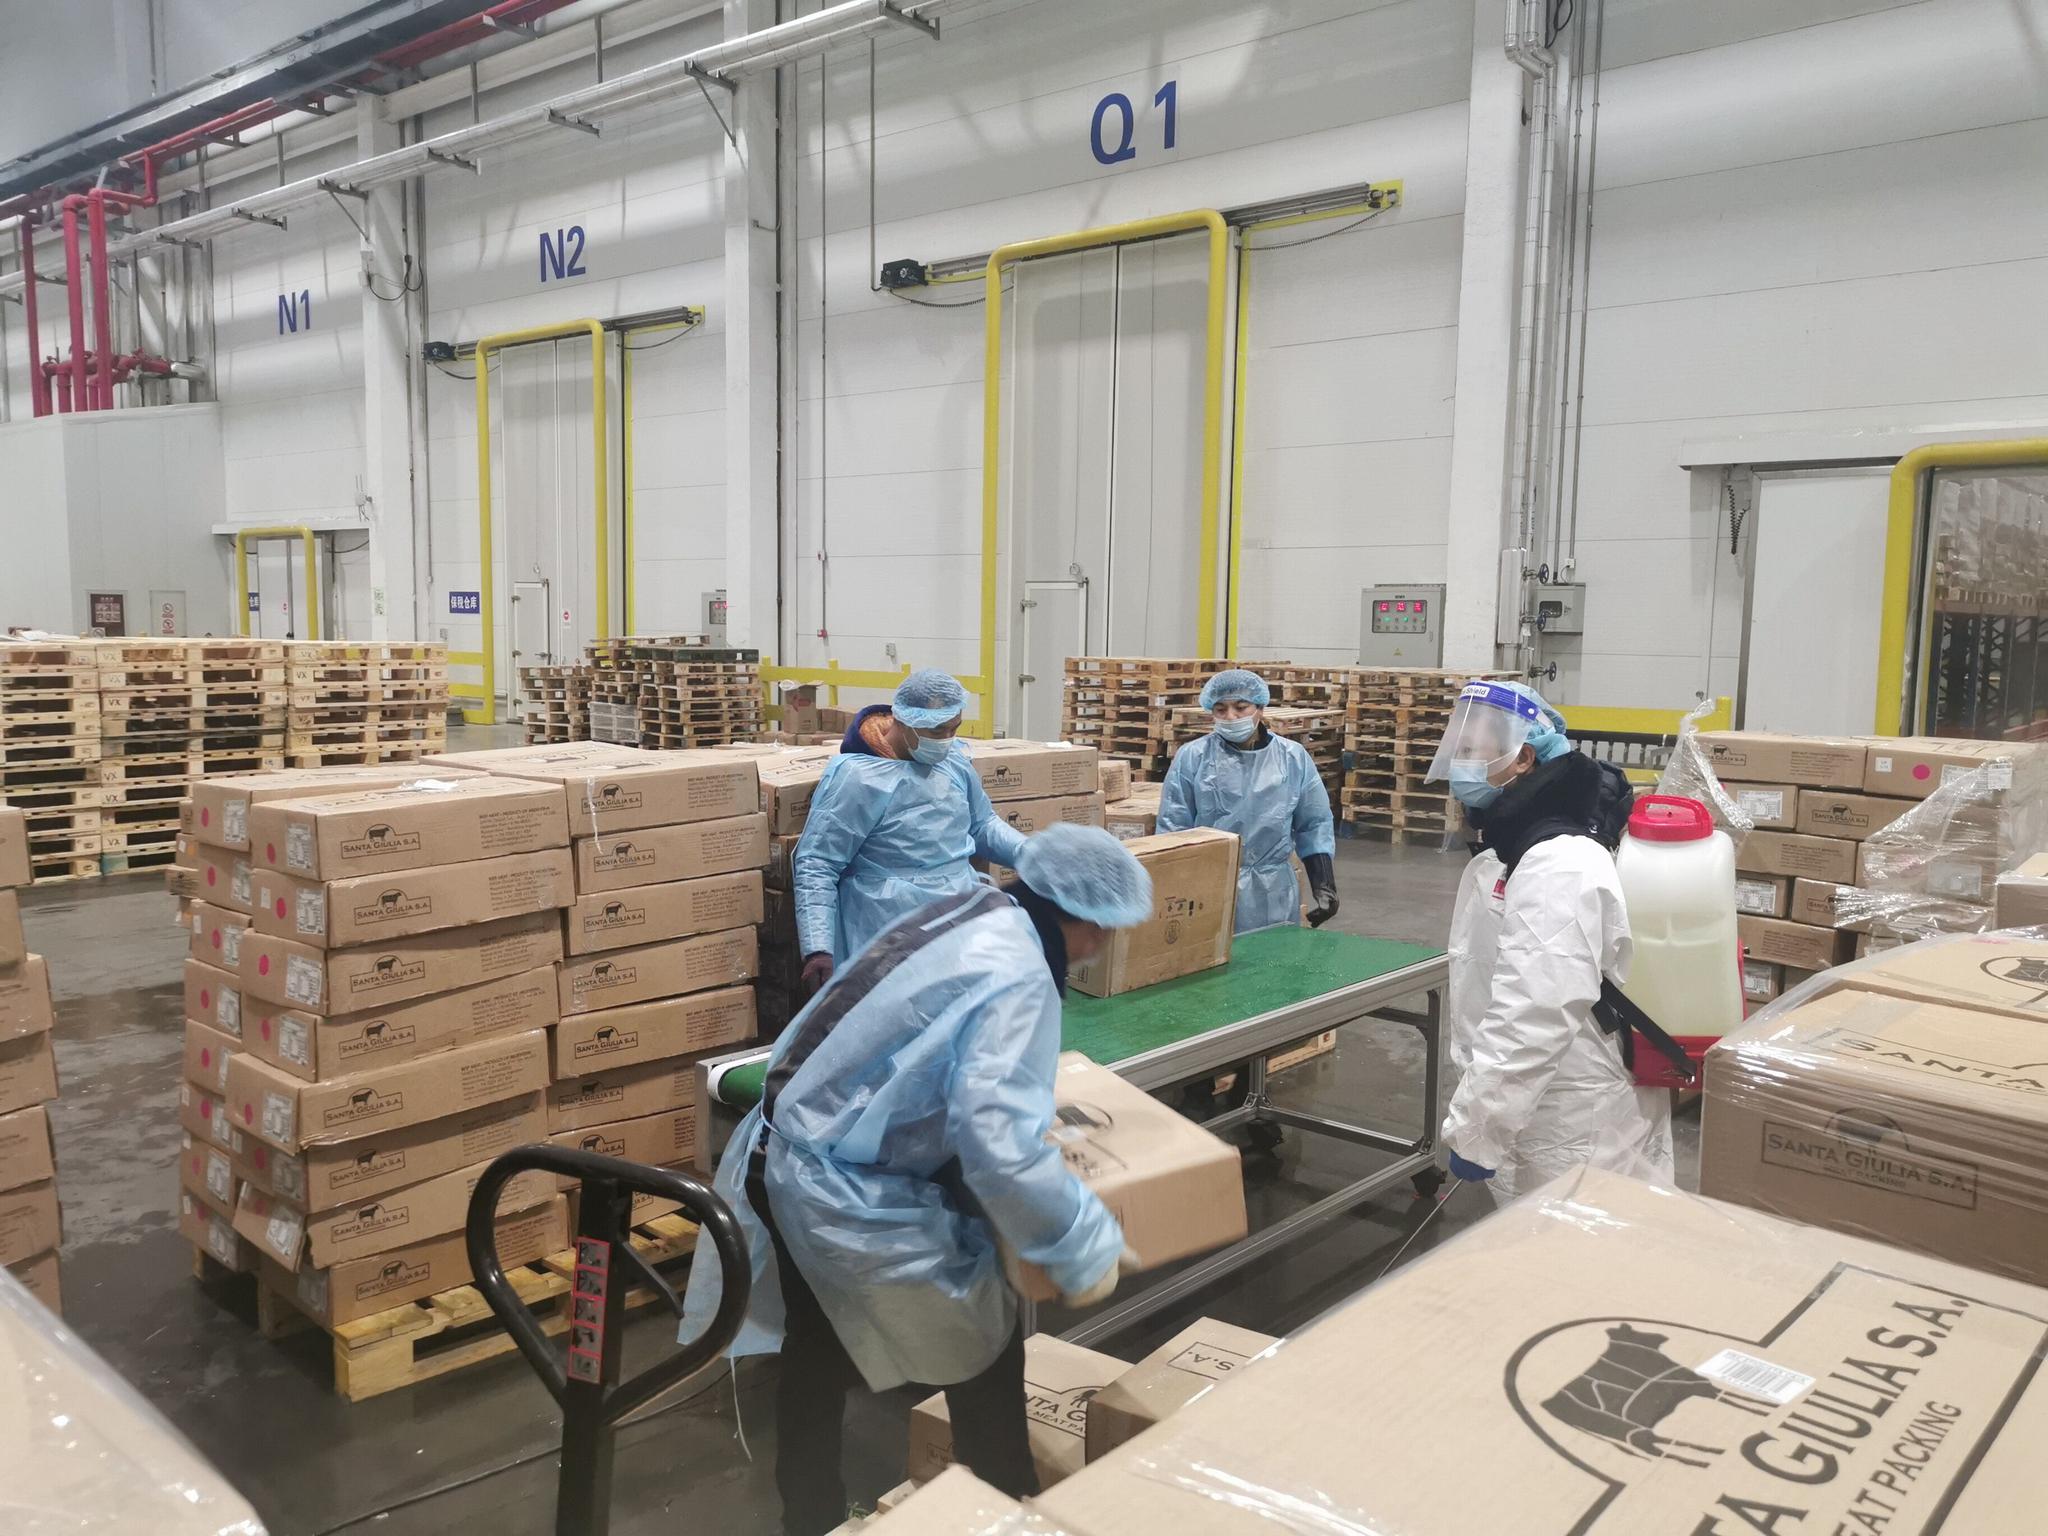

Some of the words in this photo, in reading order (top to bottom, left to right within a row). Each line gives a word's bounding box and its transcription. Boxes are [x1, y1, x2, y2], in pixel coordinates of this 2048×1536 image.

[1090, 80, 1177, 165] Q1
[539, 225, 586, 282] N2
[278, 289, 310, 335] N1
[450, 595, 478, 609] 保税仓库
[343, 843, 370, 853] SANTA
[373, 840, 401, 850] GIULIA
[403, 838, 417, 846] S.A.
[357, 909, 384, 920] SANTA
[387, 905, 414, 916] GIULIA
[415, 902, 429, 911] S.A.
[586, 919, 608, 928] SANTA
[352, 976, 380, 987] SANTA
[381, 971, 407, 981] GIULIA
[408, 967, 422, 976] S.A.
[342, 1040, 368, 1052] SANTA
[370, 1035, 396, 1047] GIULIA
[398, 1031, 412, 1040] S.A.
[576, 1044, 599, 1053] SANTA
[600, 1040, 623, 1050] GIULIA
[1839, 1037, 2045, 1089] SANTA
[326, 1109, 355, 1121] SANTA
[358, 1102, 385, 1114] GIULIA
[385, 1098, 399, 1107] S.A.
[1767, 1132, 1838, 1164] SANTA
[1844, 1149, 1921, 1182] GIULIA
[332, 1171, 360, 1182] SANTA
[334, 1224, 361, 1236] SANTA
[1187, 1351, 1235, 1372] S.A.
[1740, 1356, 1920, 1485] GIULIA
[1866, 1300, 1969, 1359] S.A.
[1870, 1400, 1963, 1496] PACKING
